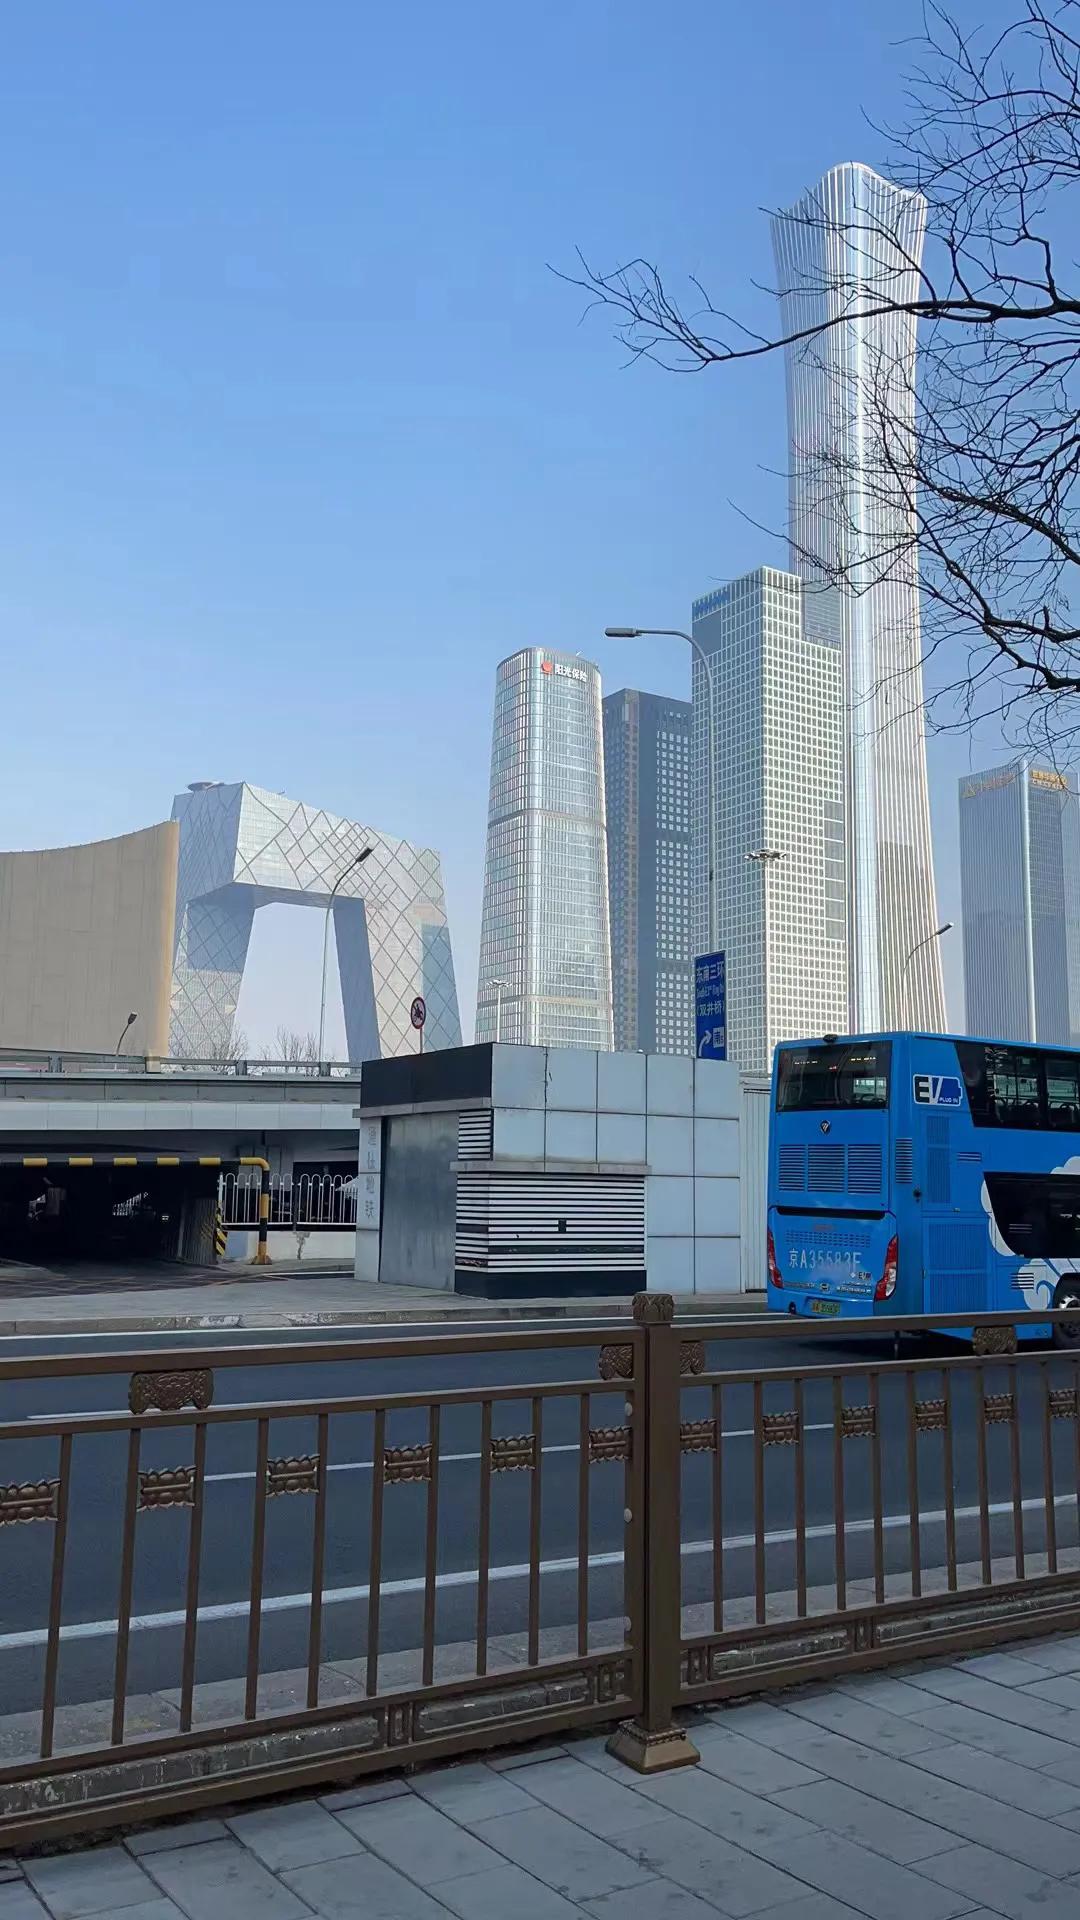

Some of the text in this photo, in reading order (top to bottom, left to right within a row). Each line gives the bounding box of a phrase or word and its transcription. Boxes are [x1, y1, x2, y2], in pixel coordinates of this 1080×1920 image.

[555, 663, 587, 682] 阳光保险
[914, 1075, 944, 1104] EV
